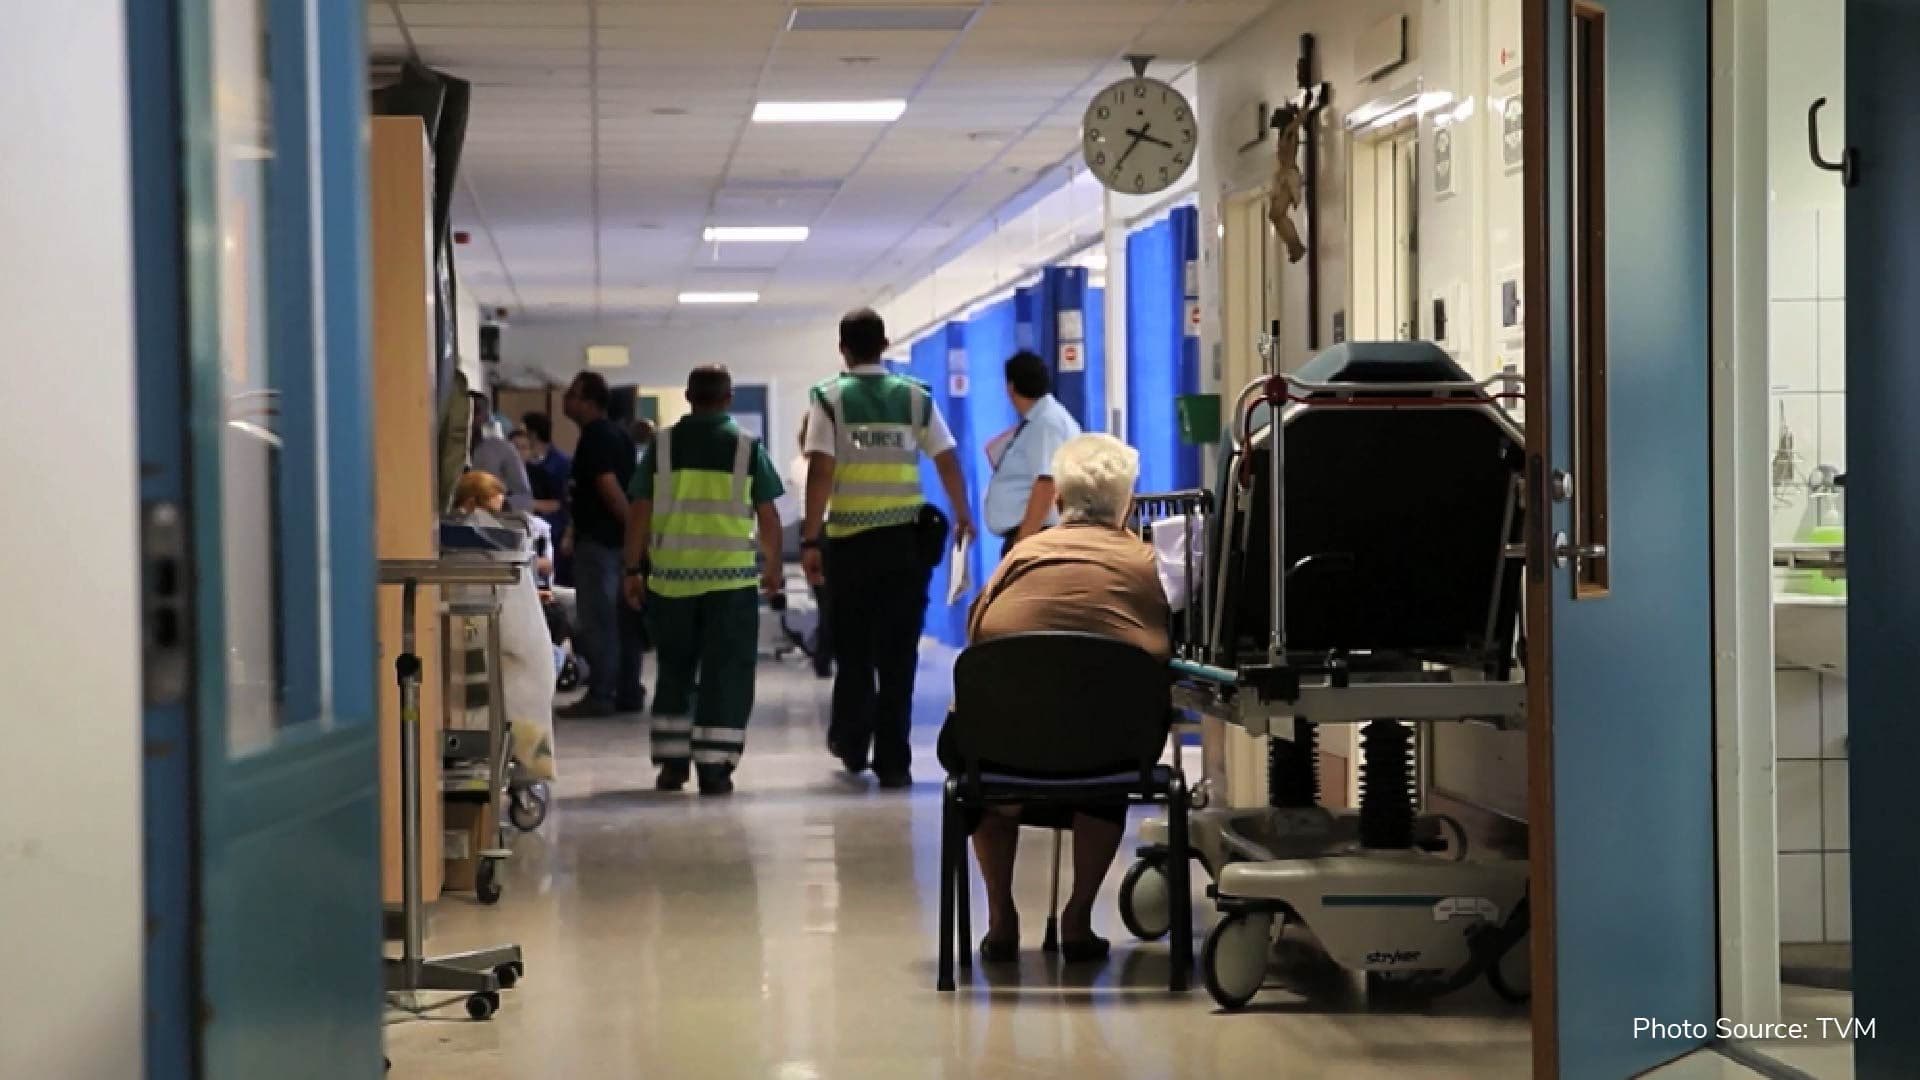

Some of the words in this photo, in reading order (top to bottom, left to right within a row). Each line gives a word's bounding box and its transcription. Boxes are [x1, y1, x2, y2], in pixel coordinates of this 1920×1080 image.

[1114, 91, 1124, 104] 11
[1134, 85, 1145, 98] 12
[1097, 106, 1109, 119] 10
[1175, 107, 1184, 121] 2
[1090, 128, 1099, 142] 9
[1182, 128, 1191, 143] 3
[1172, 152, 1183, 165] 4
[1159, 166, 1168, 182] 5
[1135, 173, 1144, 190] 6
[851, 431, 905, 448] NURSE
[1366, 949, 1421, 965] stryker
